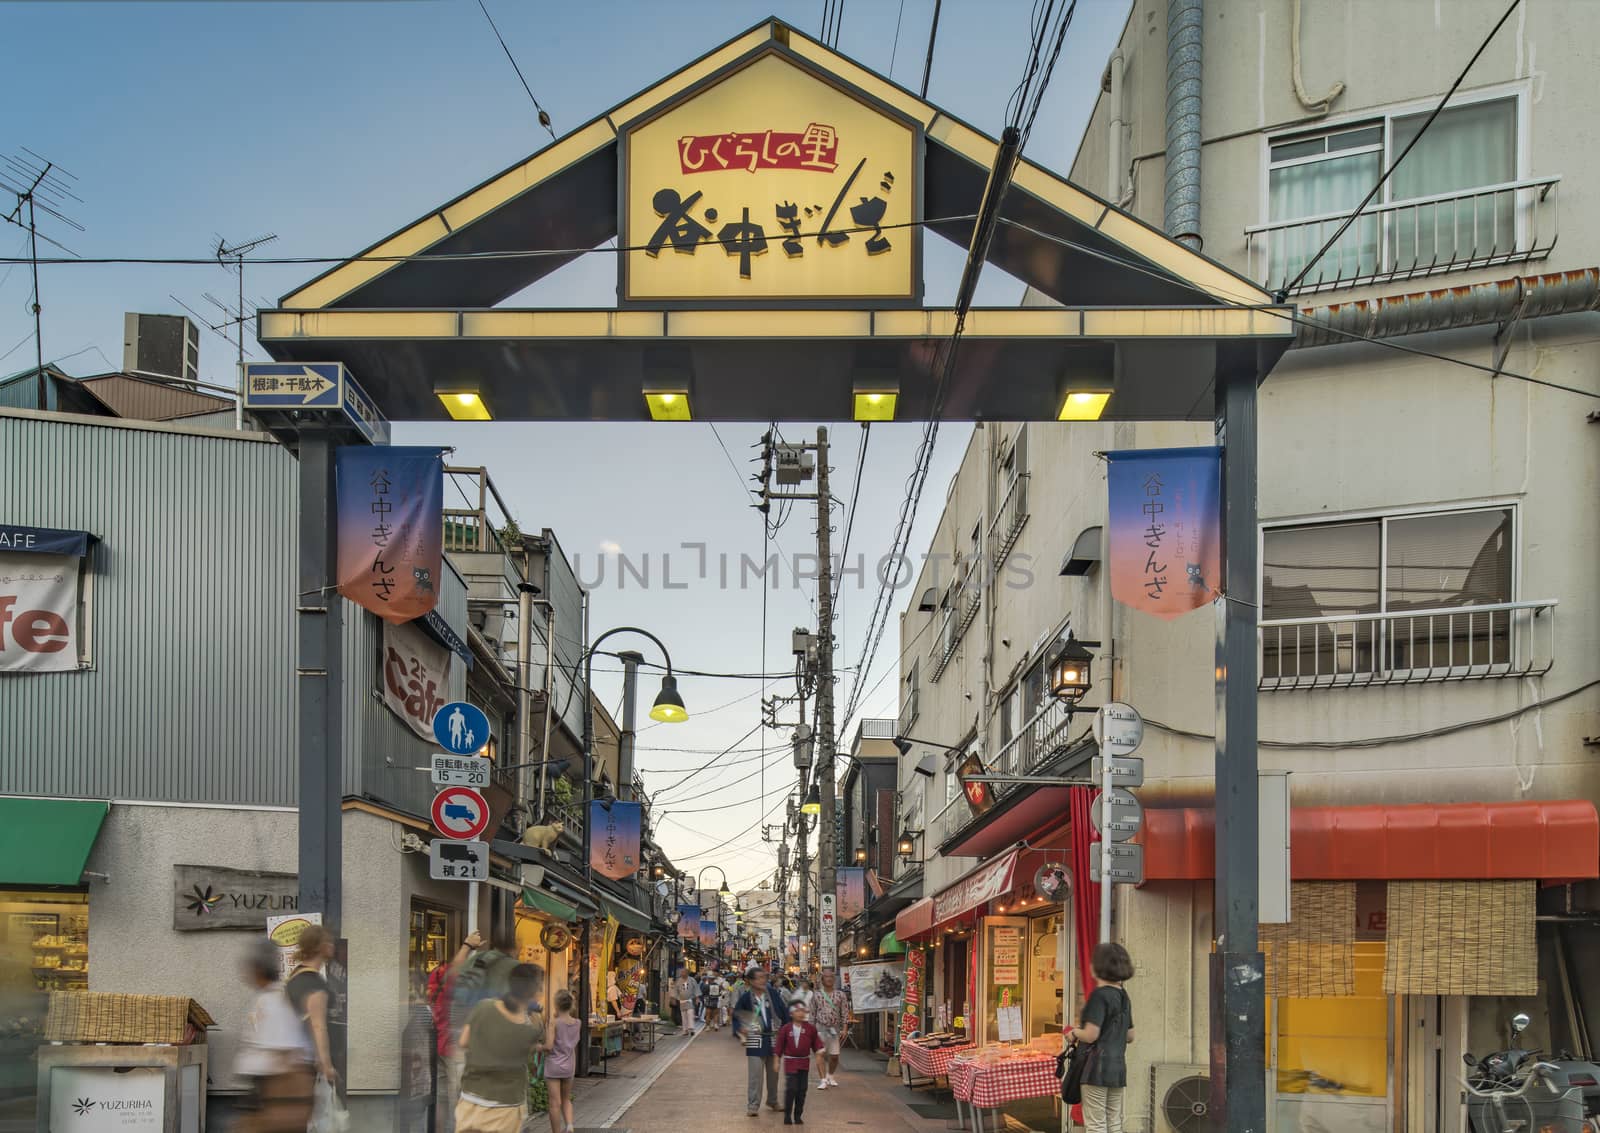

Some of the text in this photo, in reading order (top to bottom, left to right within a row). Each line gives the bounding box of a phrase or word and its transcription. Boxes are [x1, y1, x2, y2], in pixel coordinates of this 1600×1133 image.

[680, 123, 839, 172] ひぐらしの里
[645, 157, 895, 280] 谷中ぎんざ
[252, 377, 325, 392] 根津・千駄木
[369, 469, 396, 602] 谷中ぎんざ
[1142, 473, 1168, 600] 谷中ぎんざ
[411, 656, 427, 683] 2F
[434, 757, 487, 772] 自転車を除く
[438, 770, 449, 781] 15
[468, 773, 483, 784] 20
[230, 893, 299, 910] YUZURI
[100, 1099, 152, 1111] YUZURIHA
